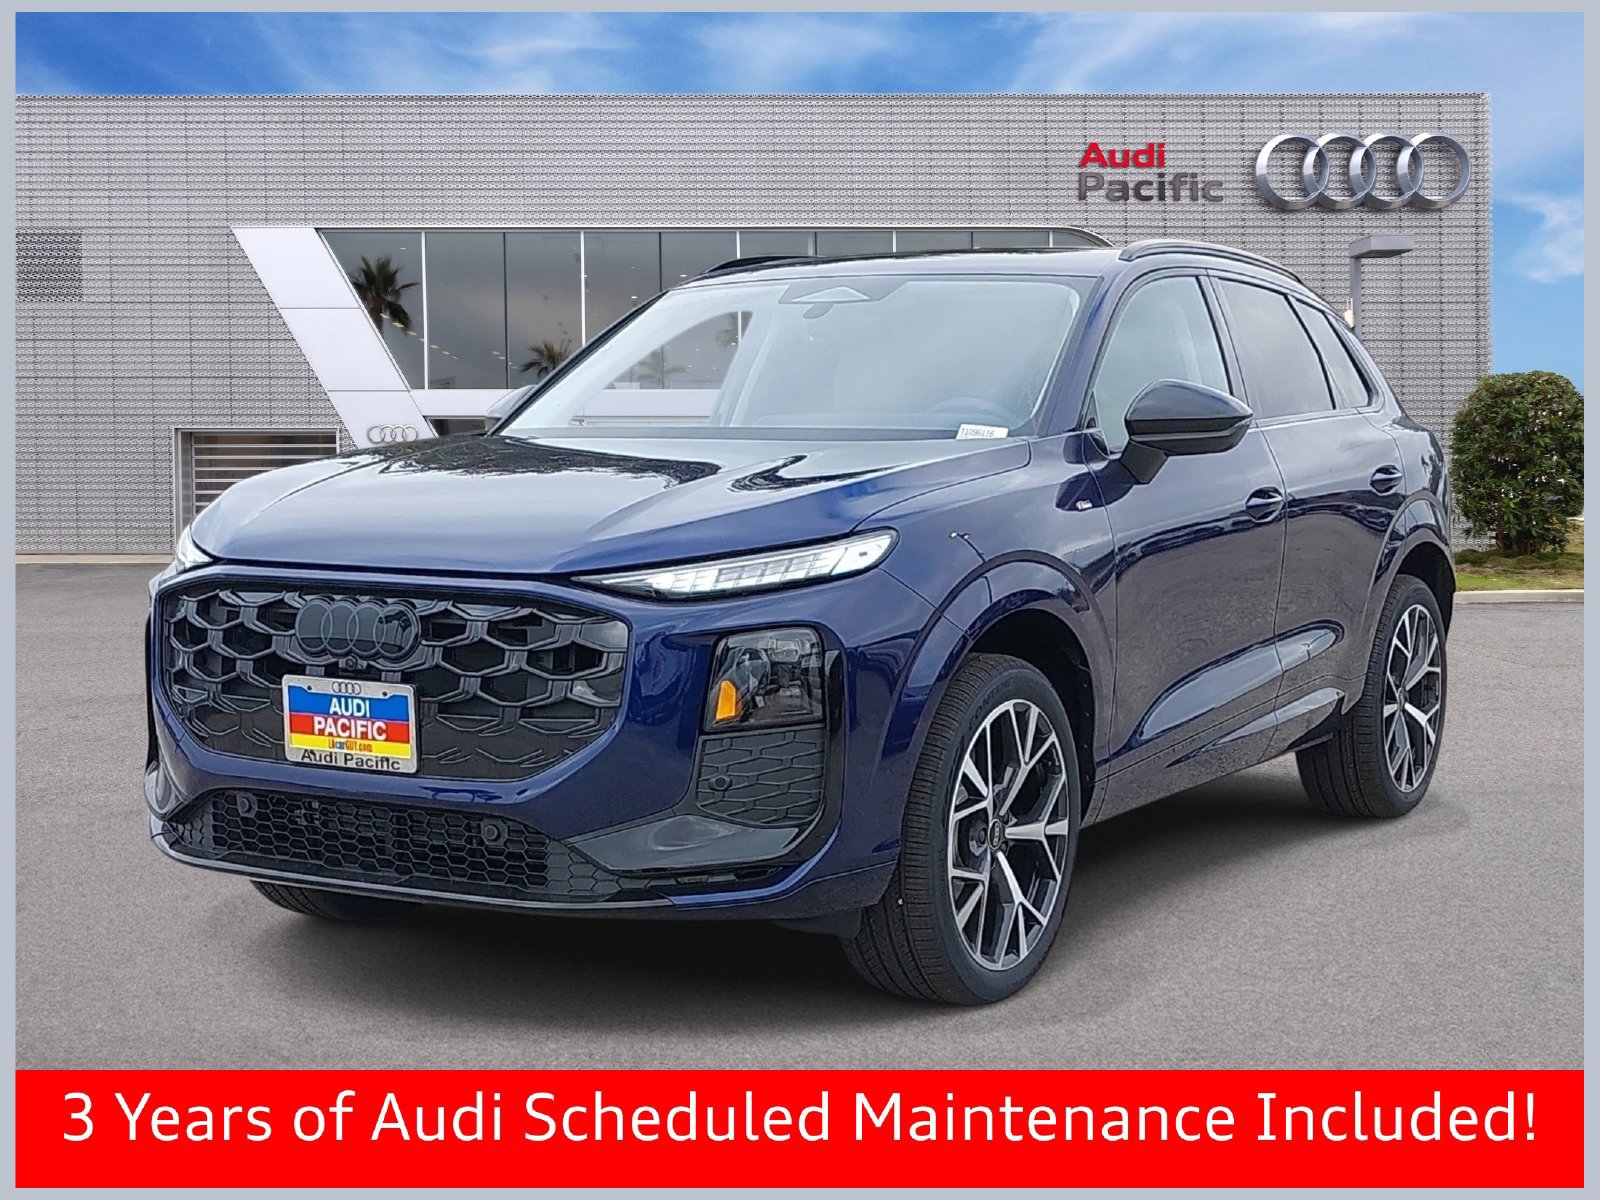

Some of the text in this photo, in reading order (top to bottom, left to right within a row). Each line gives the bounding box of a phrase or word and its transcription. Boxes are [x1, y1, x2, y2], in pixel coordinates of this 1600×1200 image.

[1079, 142, 1166, 168] Audi
[1078, 171, 1224, 202] Pacific
[329, 697, 370, 718] AUDI
[313, 716, 387, 741] PACIFIC
[301, 749, 401, 771] Audi Pacific
